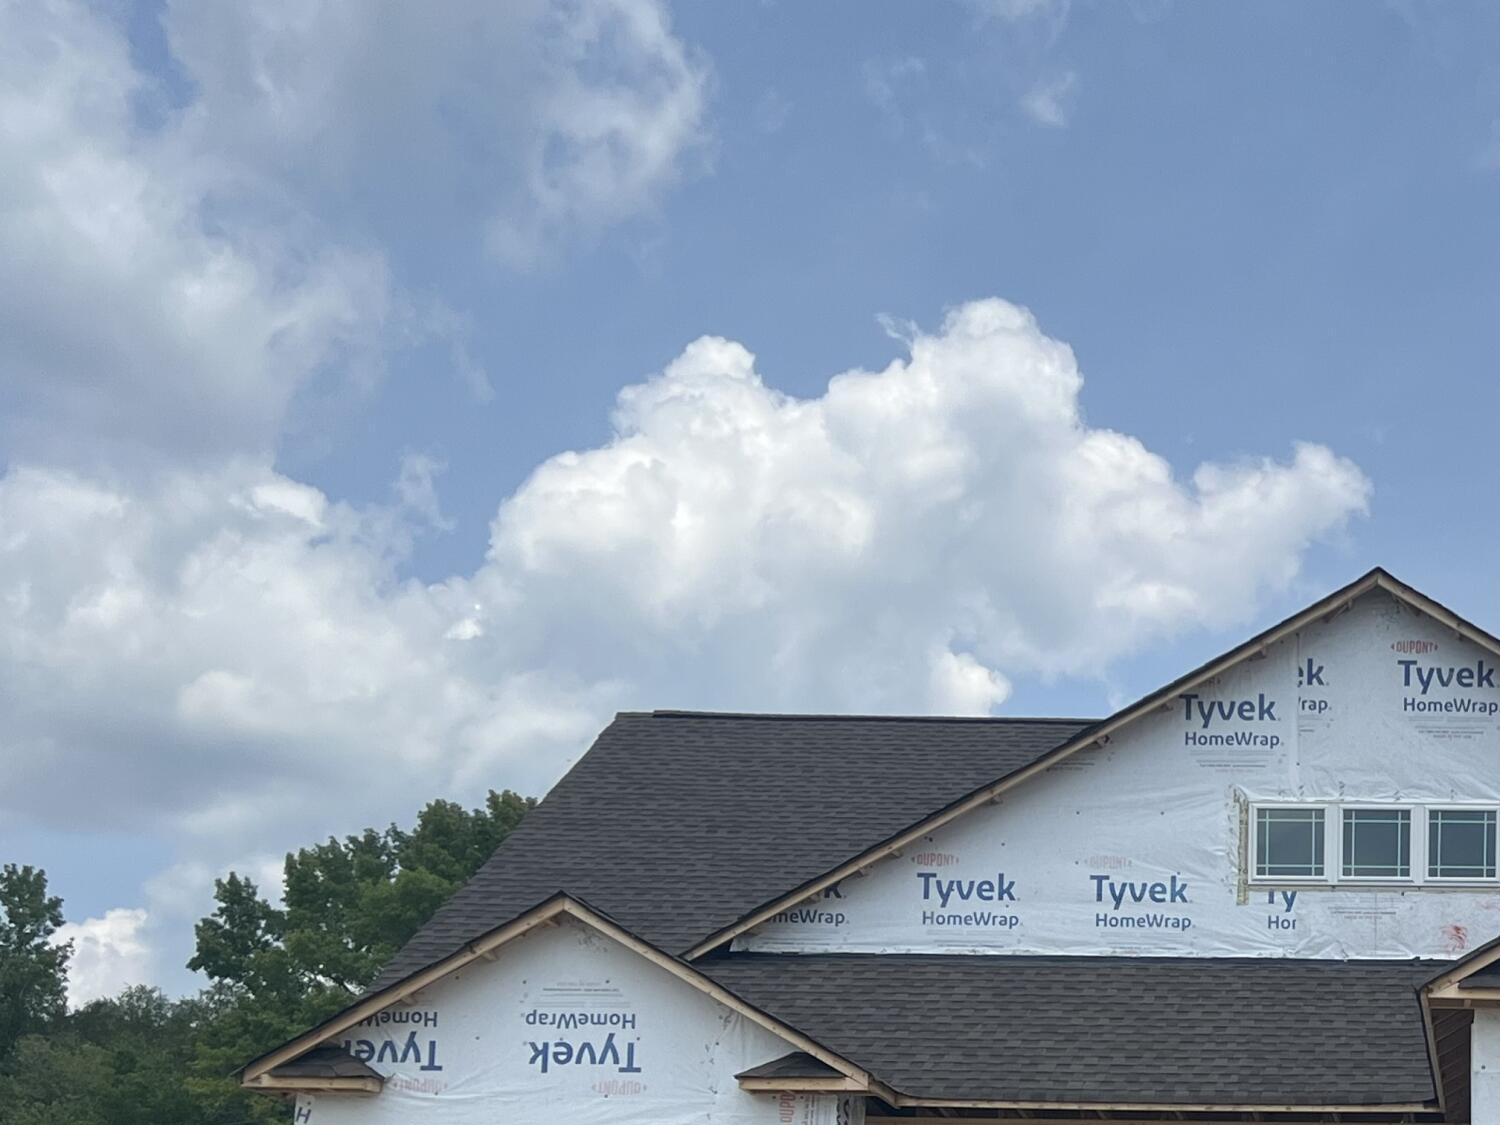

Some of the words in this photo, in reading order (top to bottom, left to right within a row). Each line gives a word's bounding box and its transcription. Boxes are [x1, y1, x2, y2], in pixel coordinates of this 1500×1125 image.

[1396, 640, 1434, 654] DUPONT
[1398, 660, 1495, 694] Tyvek
[1179, 693, 1277, 729] Tyvek
[1403, 697, 1499, 716] HomeWrap
[1185, 731, 1280, 749] HomeWrap
[916, 852, 954, 867] DUPONT
[917, 873, 1016, 908] Tyvek
[1089, 875, 1188, 911] Tyvek
[772, 909, 846, 927] meWrap
[922, 911, 1019, 929] HomeWrap
[1095, 913, 1192, 931] HomeWrap
[358, 1011, 438, 1028] HomeW
[525, 1009, 636, 1029] HomeWrap
[345, 1031, 442, 1071] Tyve
[528, 1033, 642, 1073] Tyvek
[599, 1079, 641, 1096] DUPONT
